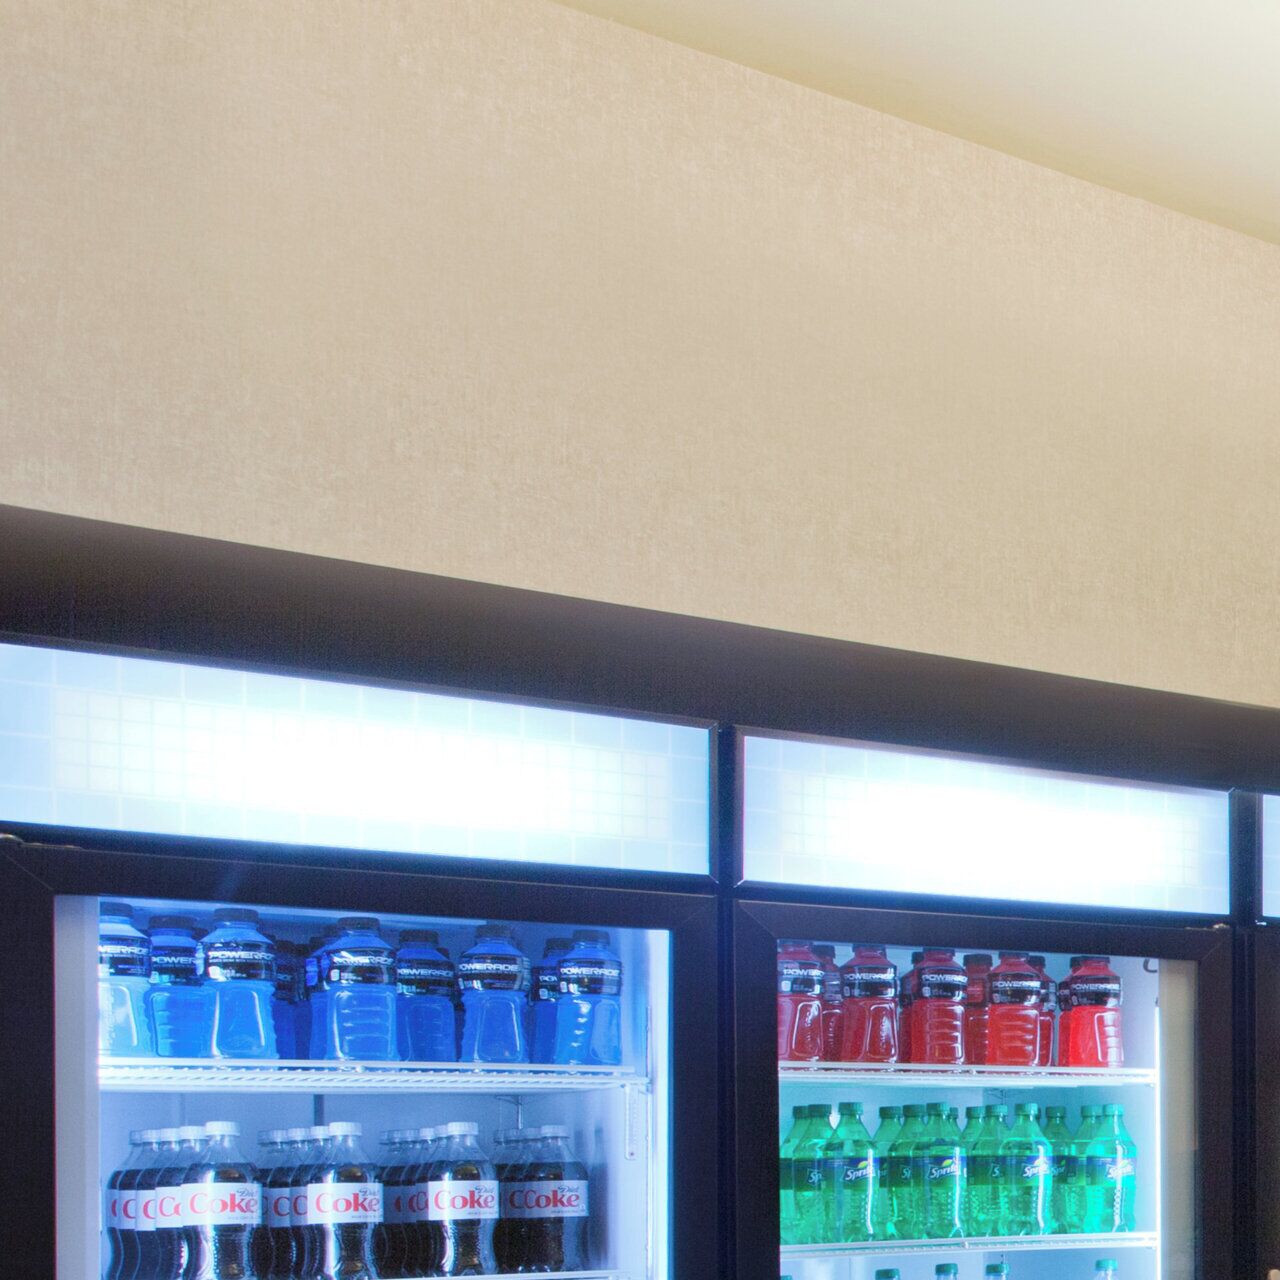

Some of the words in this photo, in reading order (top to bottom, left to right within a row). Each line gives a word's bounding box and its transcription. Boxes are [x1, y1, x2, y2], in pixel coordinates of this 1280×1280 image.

[189, 1191, 259, 1215] Coke
[315, 1191, 381, 1215] Coke
[434, 1189, 496, 1210] Coke
